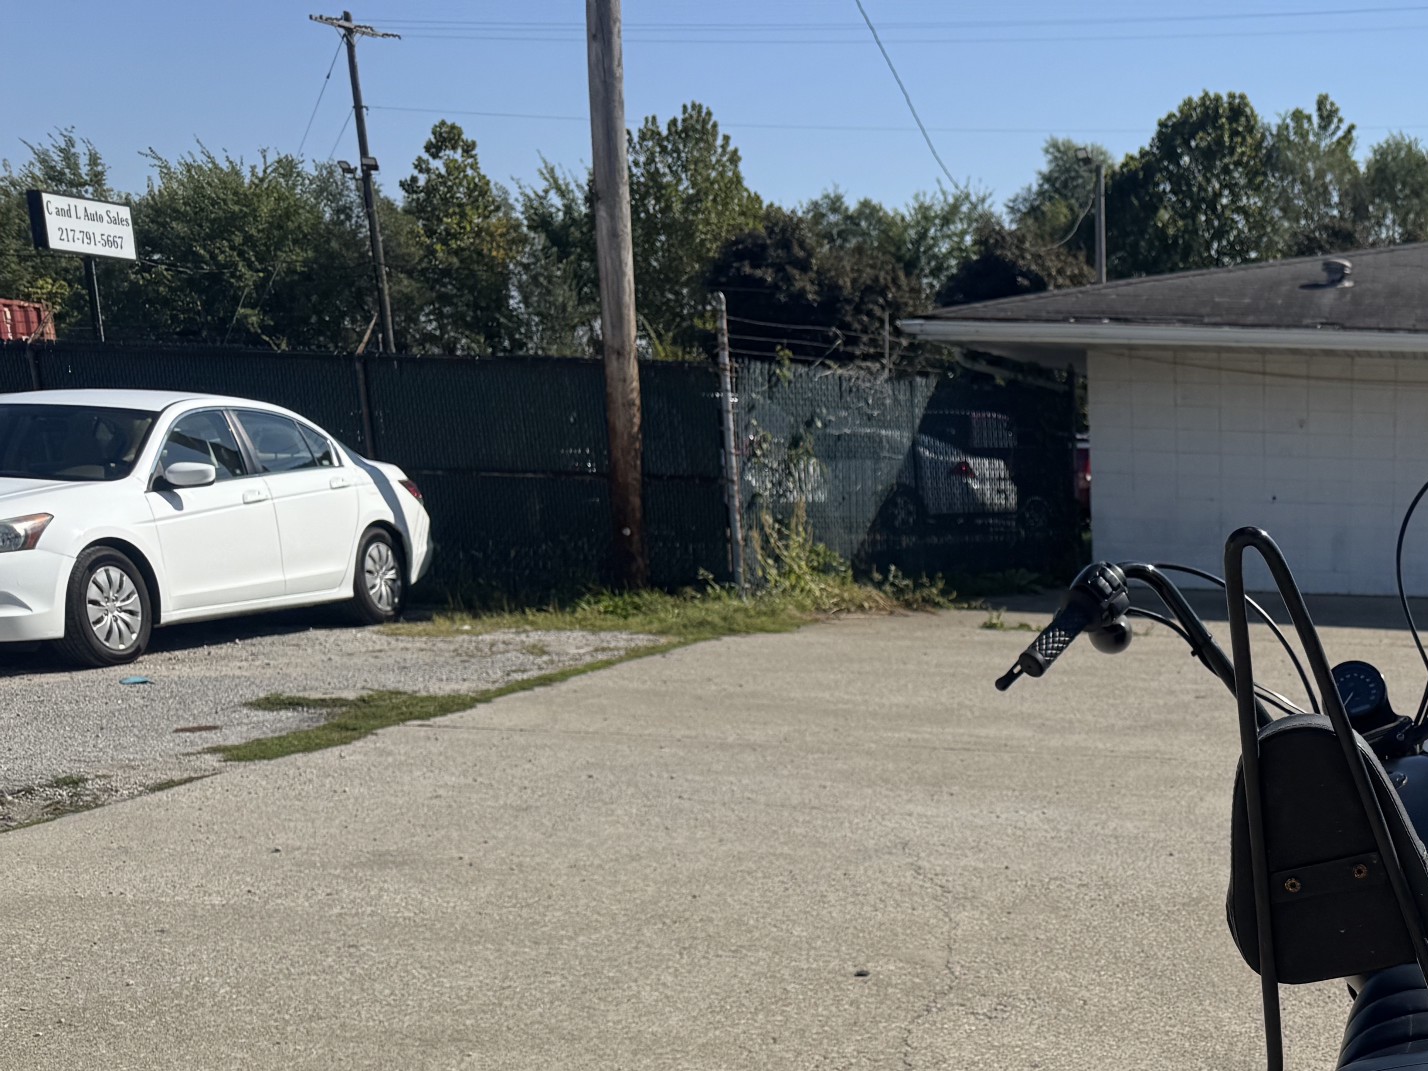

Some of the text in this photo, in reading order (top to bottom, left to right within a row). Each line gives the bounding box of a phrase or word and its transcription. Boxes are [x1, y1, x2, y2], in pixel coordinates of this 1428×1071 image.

[46, 200, 130, 227] C and L Auto Sales
[58, 227, 123, 250] 217-791-5667
